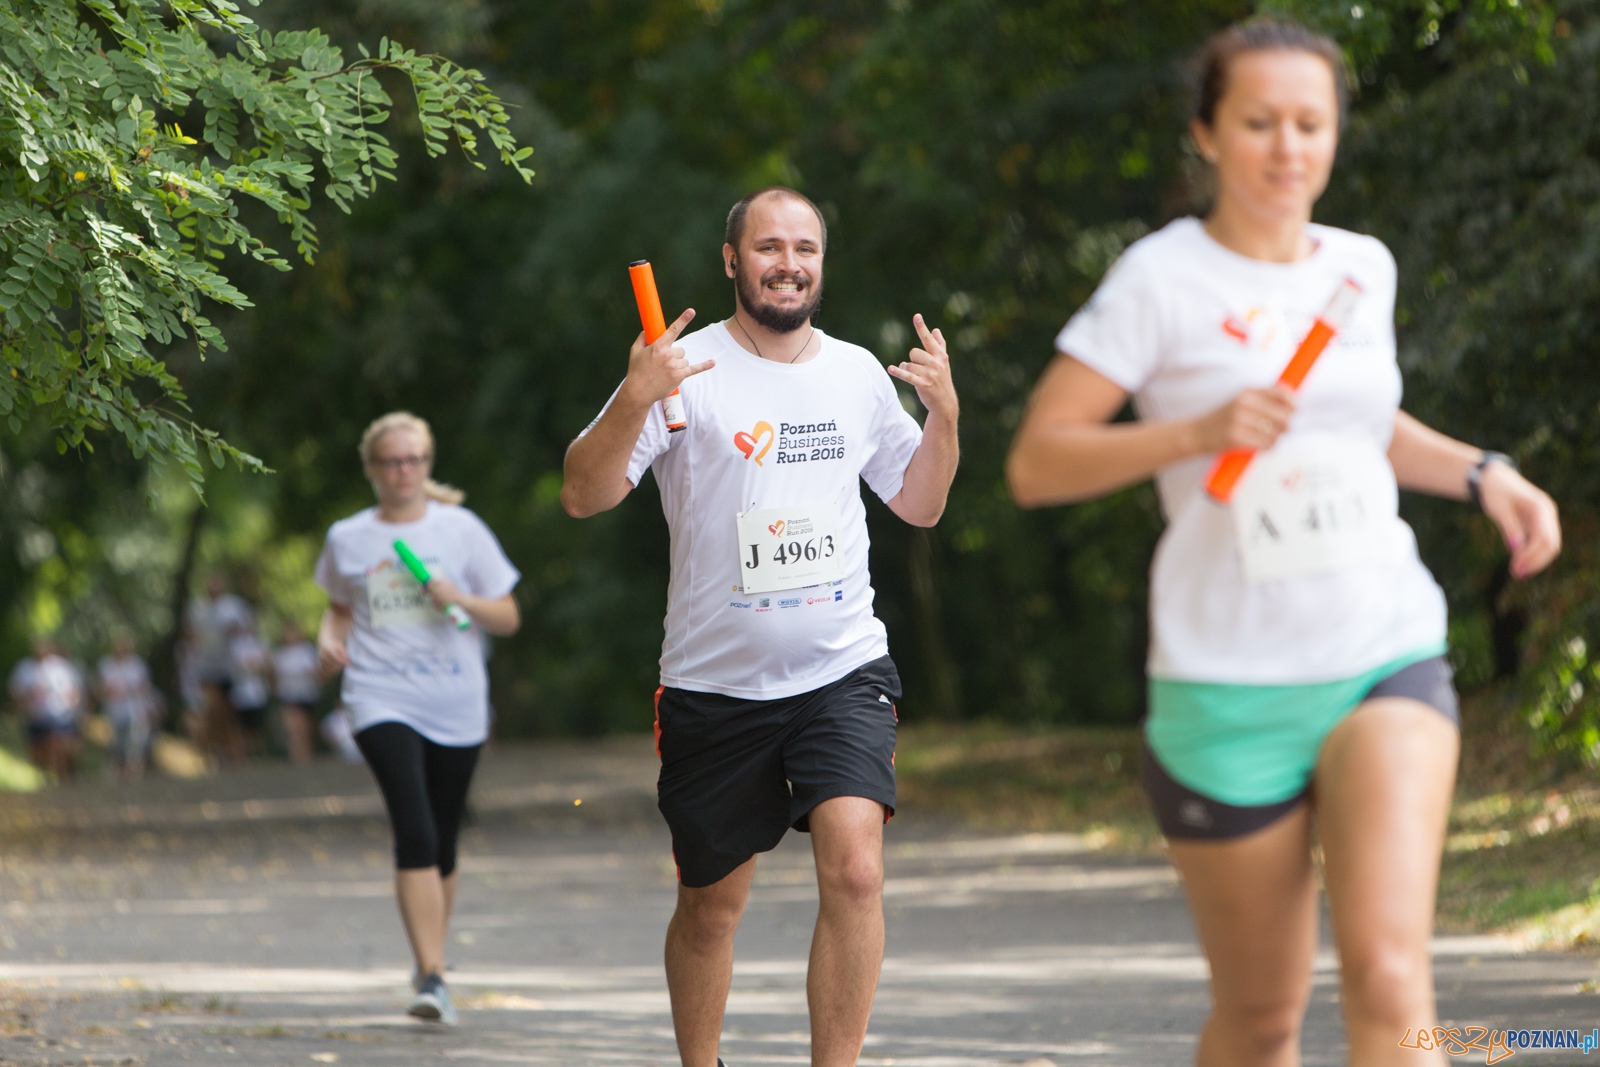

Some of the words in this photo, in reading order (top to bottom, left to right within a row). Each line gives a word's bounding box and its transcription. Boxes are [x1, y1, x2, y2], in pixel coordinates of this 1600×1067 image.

[780, 419, 837, 435] Poznań
[778, 435, 845, 450] Business
[776, 451, 808, 464] Run
[810, 446, 845, 461] 2016
[745, 543, 760, 570] J
[773, 534, 835, 565] 496/3
